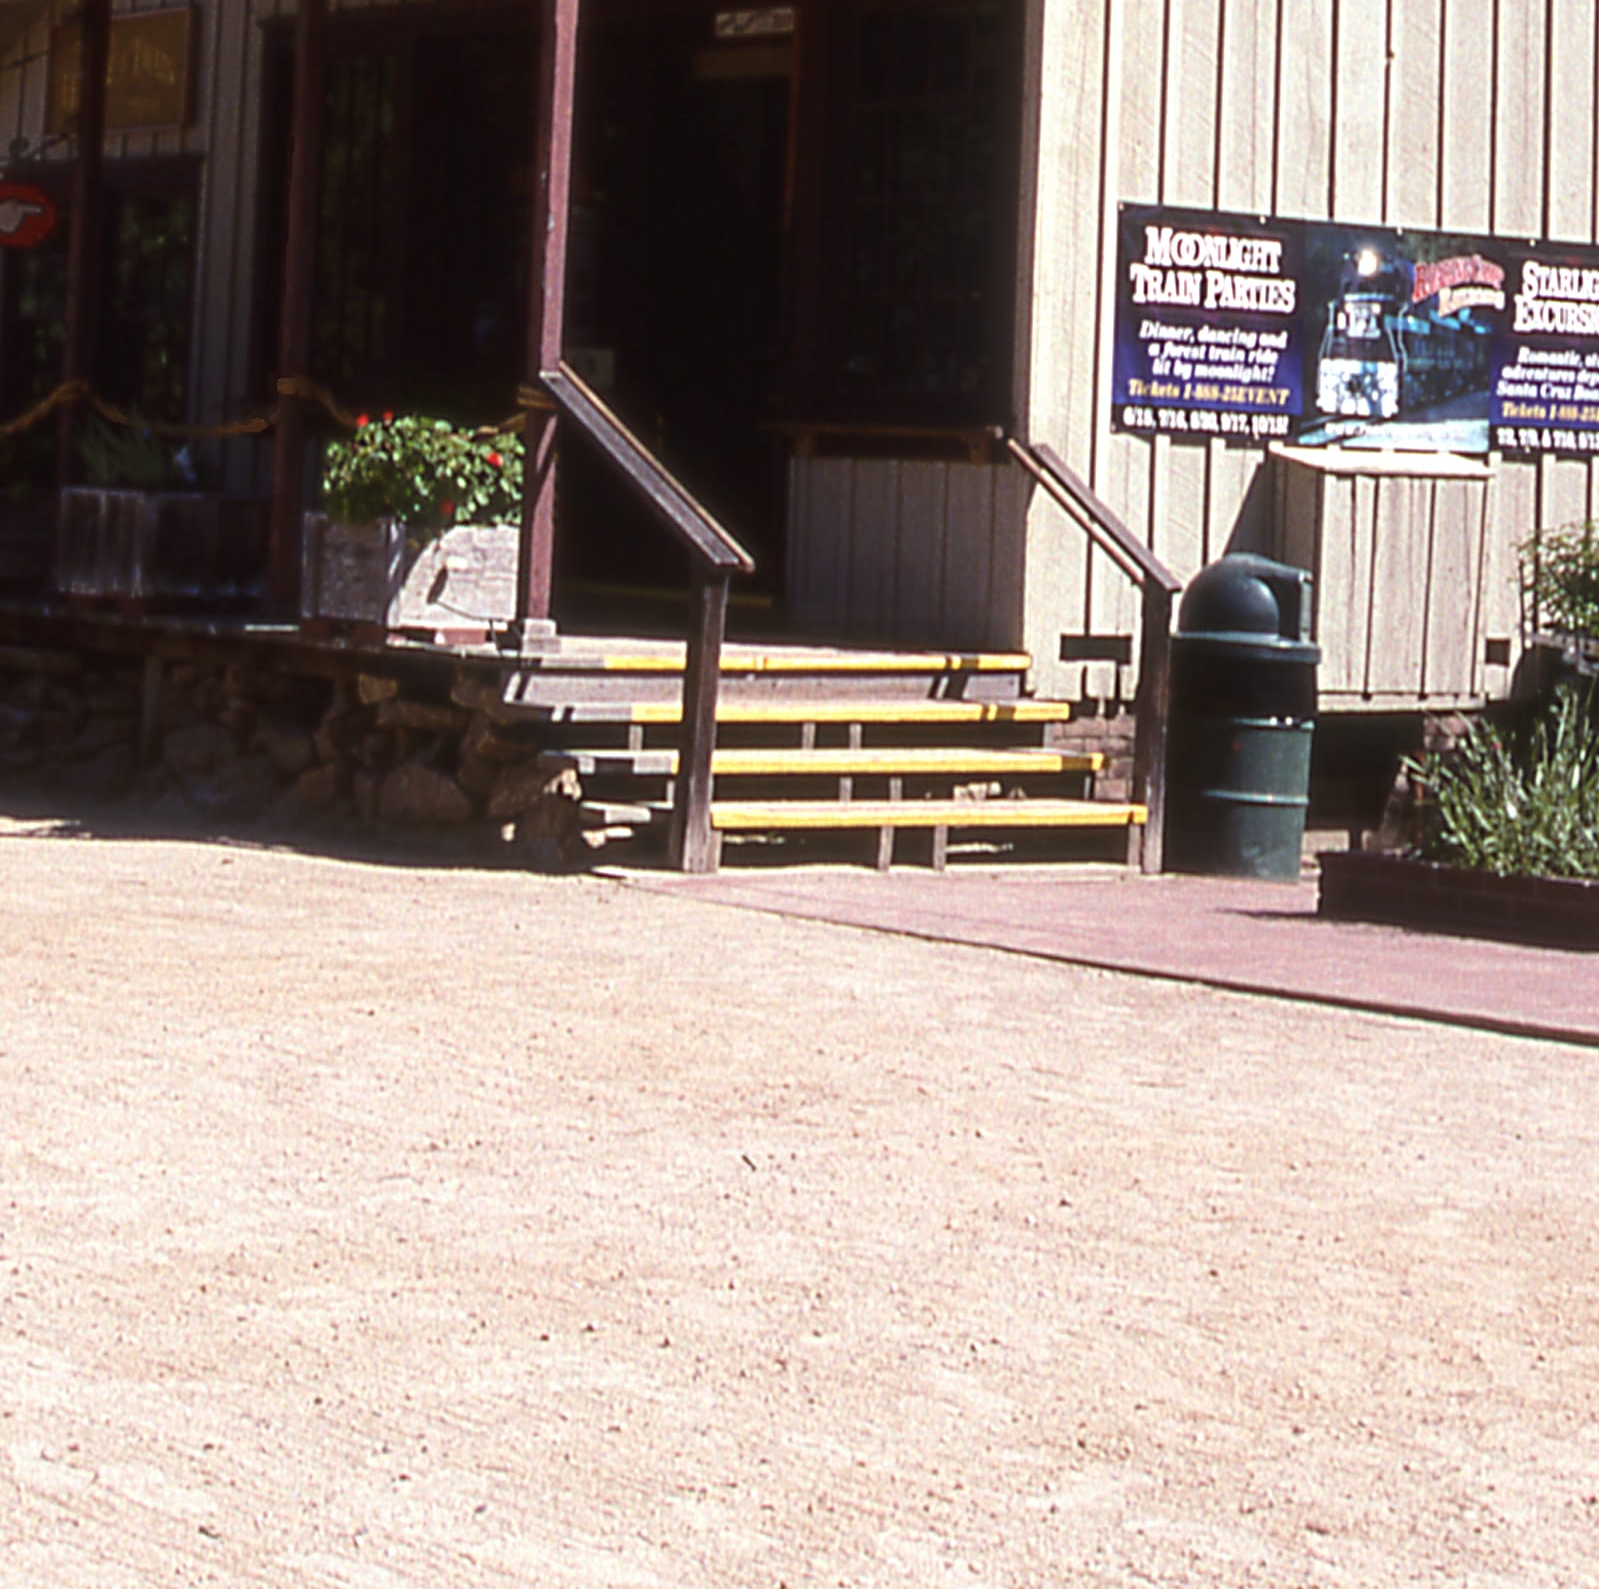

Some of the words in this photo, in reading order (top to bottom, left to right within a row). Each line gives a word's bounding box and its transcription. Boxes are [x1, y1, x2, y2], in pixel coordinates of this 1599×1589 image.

[1144, 226, 1282, 274] MOONLIGHT
[1130, 263, 1202, 305] TRAIN
[1204, 270, 1296, 313] PARTIES
[1139, 320, 1195, 344] Dinner,
[1197, 325, 1257, 348] dancing
[1259, 331, 1288, 349] and
[1148, 344, 1160, 357] a
[1162, 341, 1206, 360] forest
[1209, 345, 1245, 363] train
[1248, 348, 1278, 364] ride
[1517, 346, 1582, 367] Romantic,
[1152, 360, 1171, 375] lit
[1173, 361, 1192, 380] by
[1195, 364, 1275, 383] moonlight!
[1129, 379, 1180, 398] Tickets
[1496, 380, 1538, 397] Santa
[1540, 382, 1573, 400] Cruz
[1502, 402, 1546, 419] Tickets
